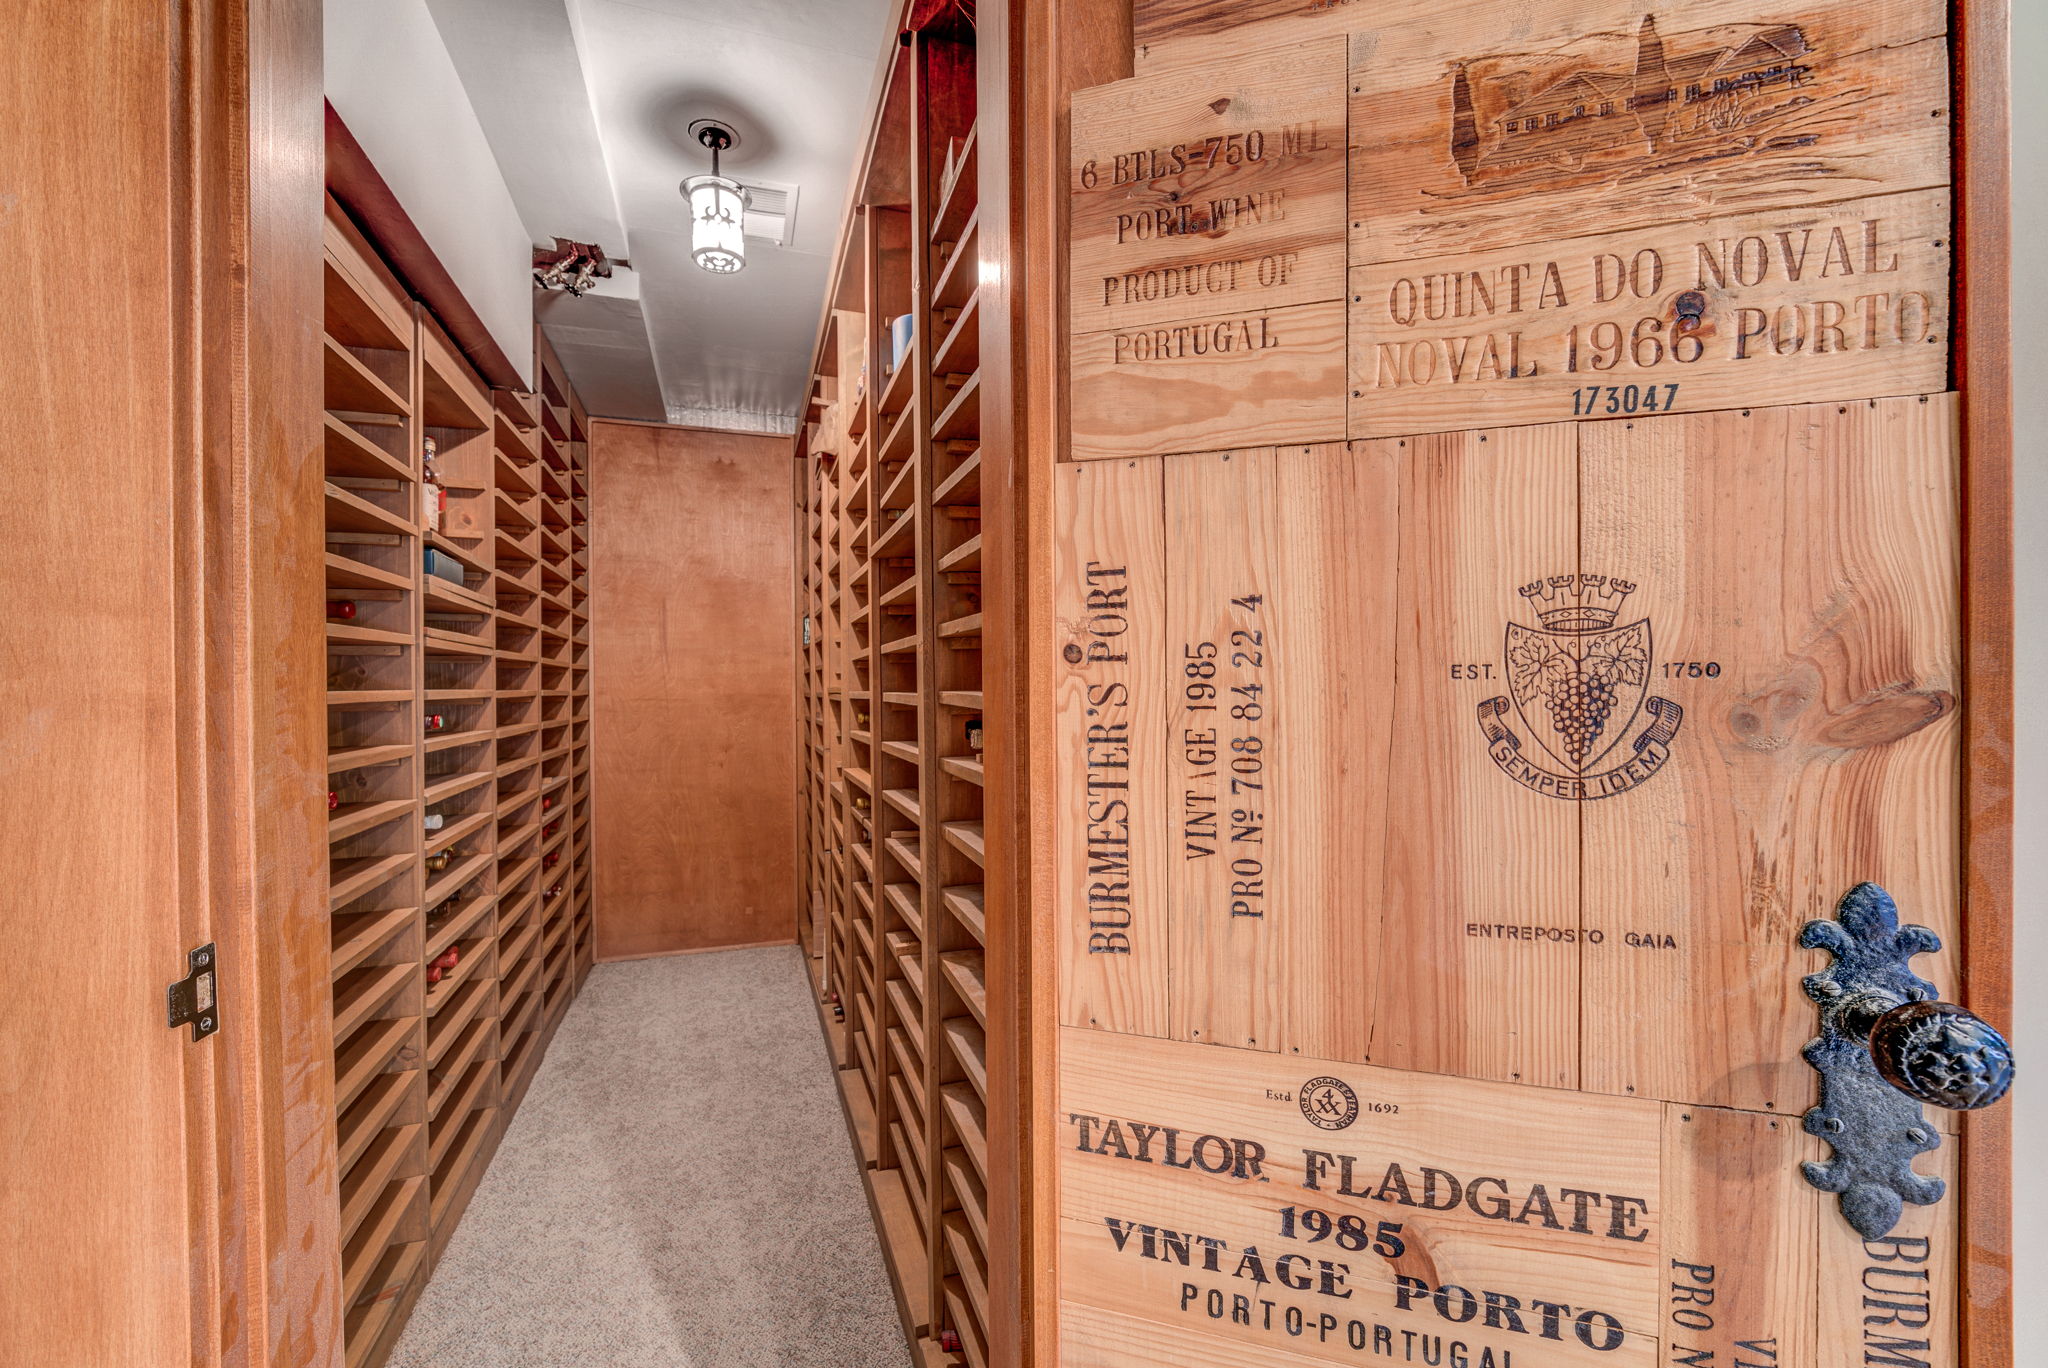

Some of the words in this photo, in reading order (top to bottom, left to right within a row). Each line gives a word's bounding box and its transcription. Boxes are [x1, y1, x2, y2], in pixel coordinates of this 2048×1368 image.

[1080, 159, 1098, 190] 6
[1111, 129, 1265, 186] BTLS-750
[1280, 120, 1328, 157] ML
[1116, 203, 1193, 245] PORT
[1208, 188, 1286, 231] WINE
[1102, 258, 1242, 307] PRODUCT
[1257, 252, 1298, 287] OF
[1390, 262, 1568, 327] QUINTA
[1593, 247, 1663, 303] DO
[1697, 219, 1898, 290] NOVAL
[1113, 317, 1279, 365] PORTUGAL
[1376, 332, 1538, 389] NOVAL
[1566, 316, 1705, 373] 1966
[1732, 291, 1930, 361] PORTO
[1572, 383, 1680, 416] 173047
[1087, 561, 1128, 665] PORT
[1231, 593, 1263, 614] 4
[1231, 629, 1263, 668] 22
[1451, 663, 1497, 680] EST.
[1662, 661, 1721, 679] 1750
[1185, 641, 1218, 713] 1985
[1231, 683, 1263, 722] 84
[1231, 736, 1263, 796] 708
[1495, 746, 1587, 798] SEMPER
[1599, 748, 1662, 795] IDEM
[1087, 682, 1131, 956] BURMESTER'S
[1231, 859, 1263, 921] PRO
[1466, 922, 1604, 945] ENTREPOSTO
[1624, 931, 1677, 950] GAIA
[1368, 1102, 1400, 1115] 1692
[1069, 1113, 1270, 1184] TAYLOR
[1301, 1148, 1650, 1243] FLADGATE
[1277, 1205, 1406, 1259] 1985
[1103, 1216, 1354, 1300] VINTAGE
[1393, 1273, 1626, 1352] PORTO
[1671, 1258, 1715, 1330] PRO
